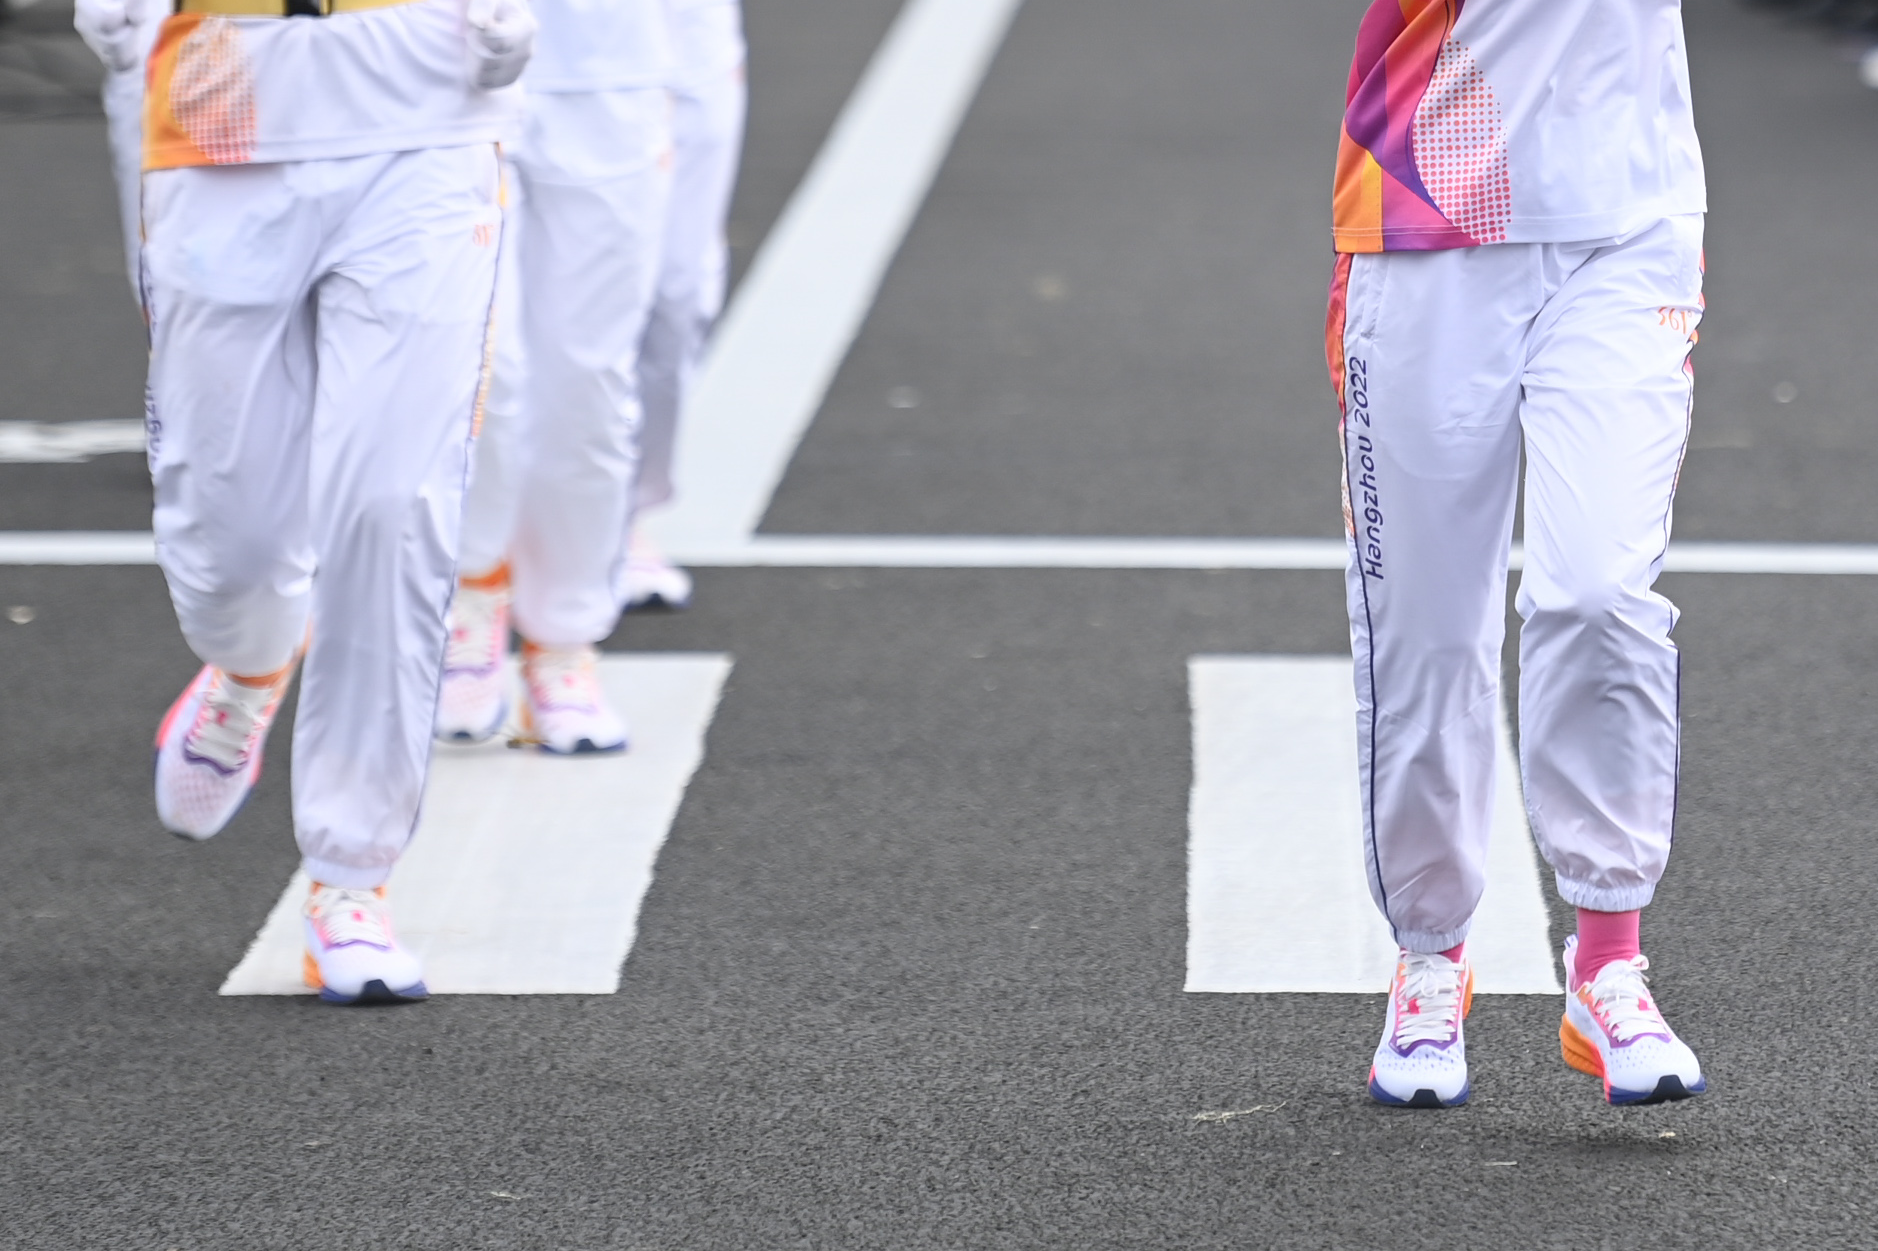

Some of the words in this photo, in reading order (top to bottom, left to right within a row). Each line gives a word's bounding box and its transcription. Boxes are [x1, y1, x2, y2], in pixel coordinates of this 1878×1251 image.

[1657, 305, 1693, 336] 361°
[1349, 356, 1372, 429] 2022
[1358, 434, 1385, 581] Hangzhou
